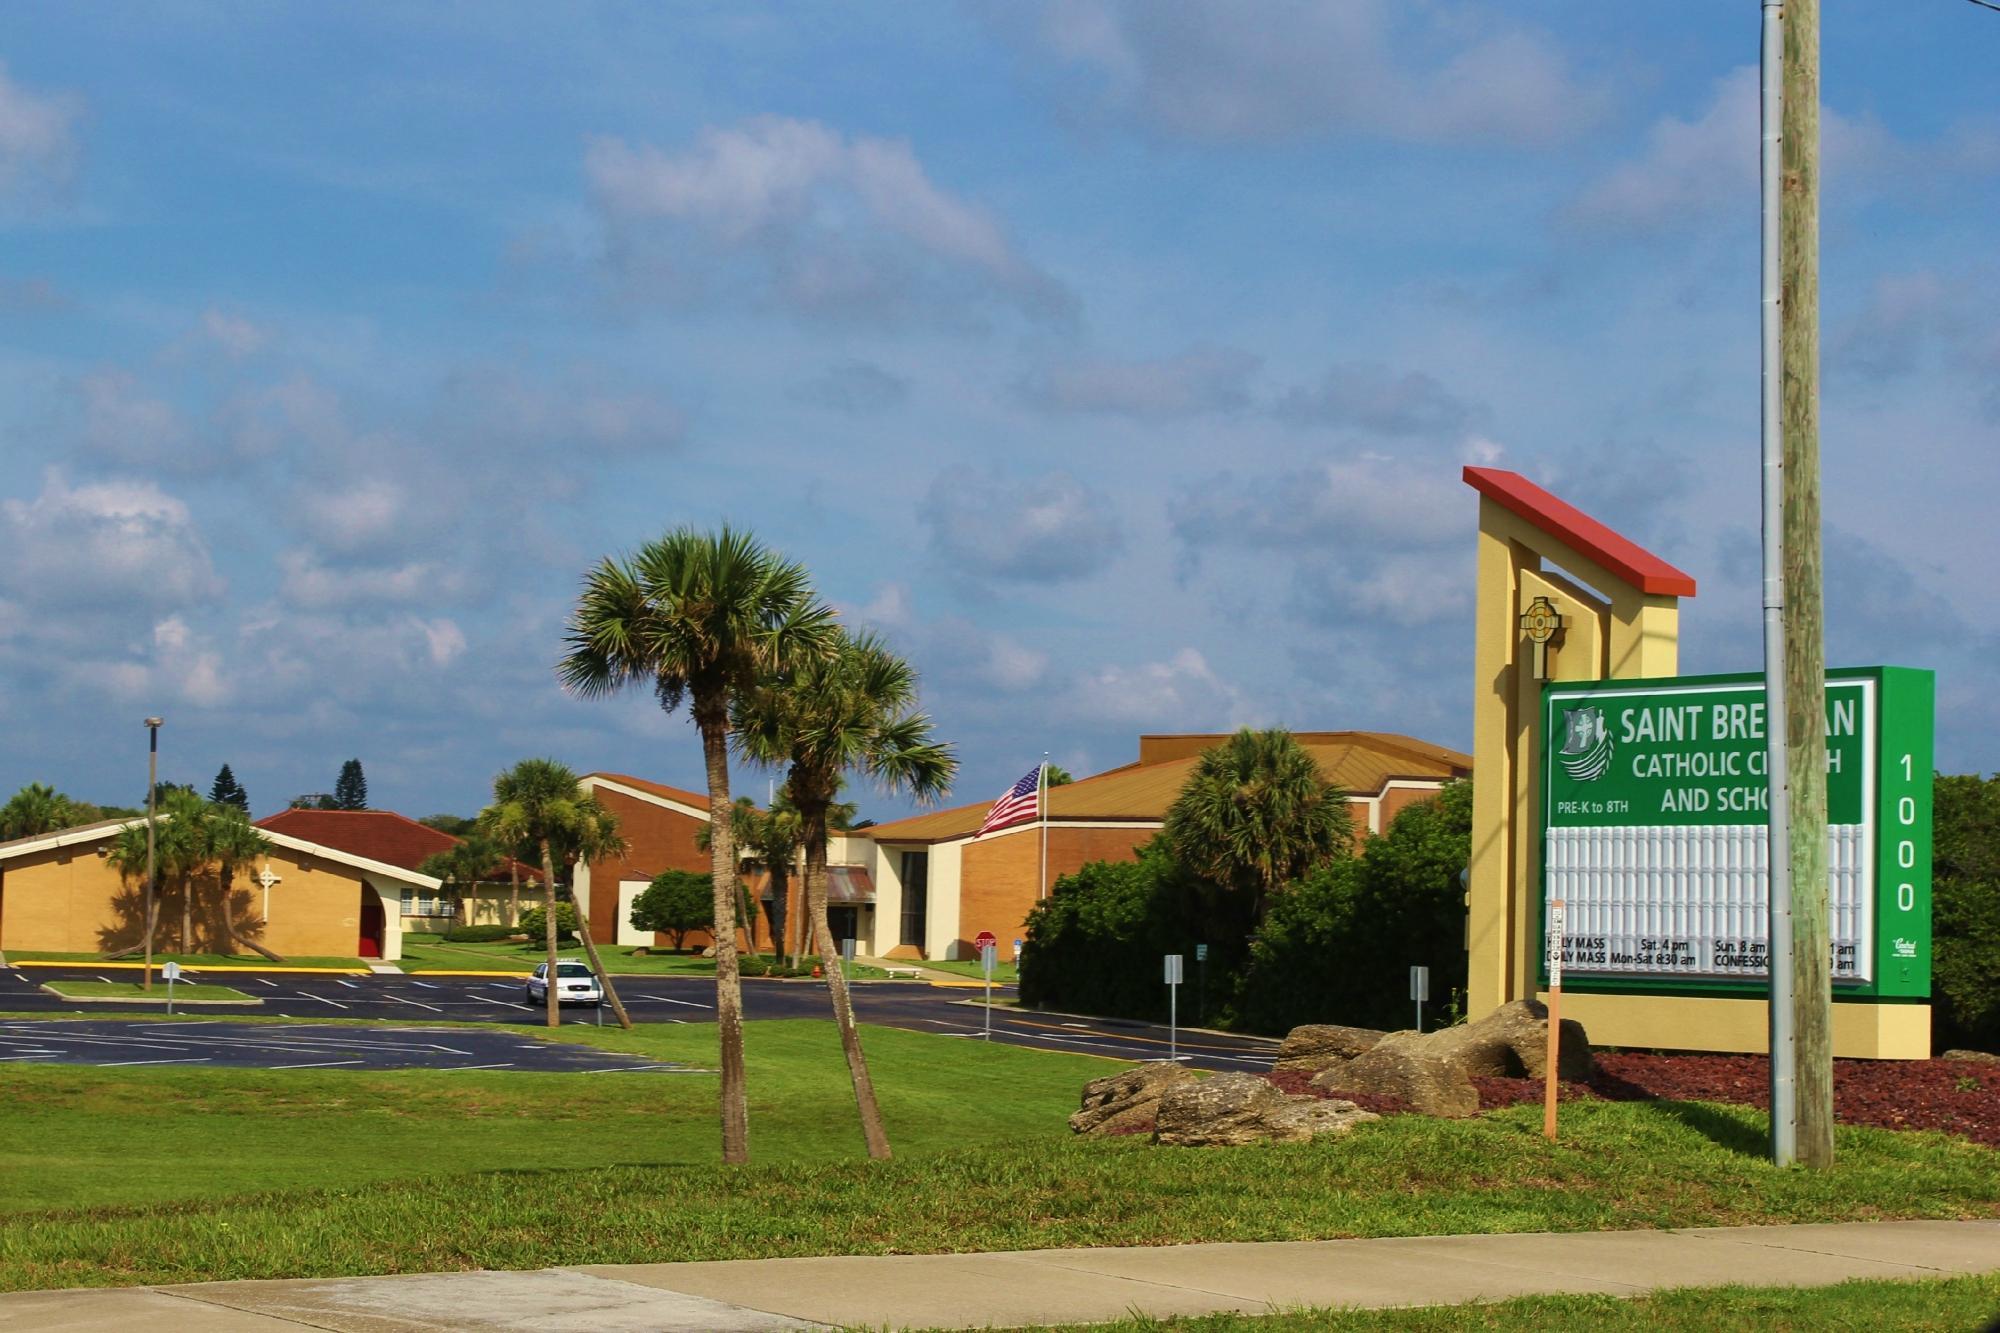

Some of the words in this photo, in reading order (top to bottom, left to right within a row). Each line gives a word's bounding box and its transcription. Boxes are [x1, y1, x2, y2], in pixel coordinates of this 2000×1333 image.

[1621, 706, 1703, 743] SAINT
[1712, 700, 1854, 740] BREN
[1632, 751, 1740, 777] CATHOLIC
[1558, 801, 1589, 814] PRE-K
[1592, 802, 1603, 813] to
[1606, 801, 1629, 813] 8TH
[1661, 789, 1709, 812] AND
[1717, 786, 1768, 811] SCH
[1898, 754, 1915, 911] 1000
[976, 938, 996, 948] STOP
[1547, 937, 1573, 948] HLY
[1575, 937, 1605, 949] MASS
[1641, 939, 1660, 950] Sat.
[1662, 939, 1669, 950] 4
[1671, 941, 1689, 953] pm
[1715, 940, 1736, 952] Sun.
[1740, 940, 1746, 952] 8
[1750, 943, 1765, 952] am
[1838, 945, 1855, 955] am
[1576, 952, 1606, 963] MASS
[1611, 953, 1653, 964] Mon-Sat
[1656, 954, 1677, 965] 8:30
[1680, 956, 1696, 965] am
[1714, 955, 1769, 967] CONFESSIO
[1837, 960, 1854, 970] am
